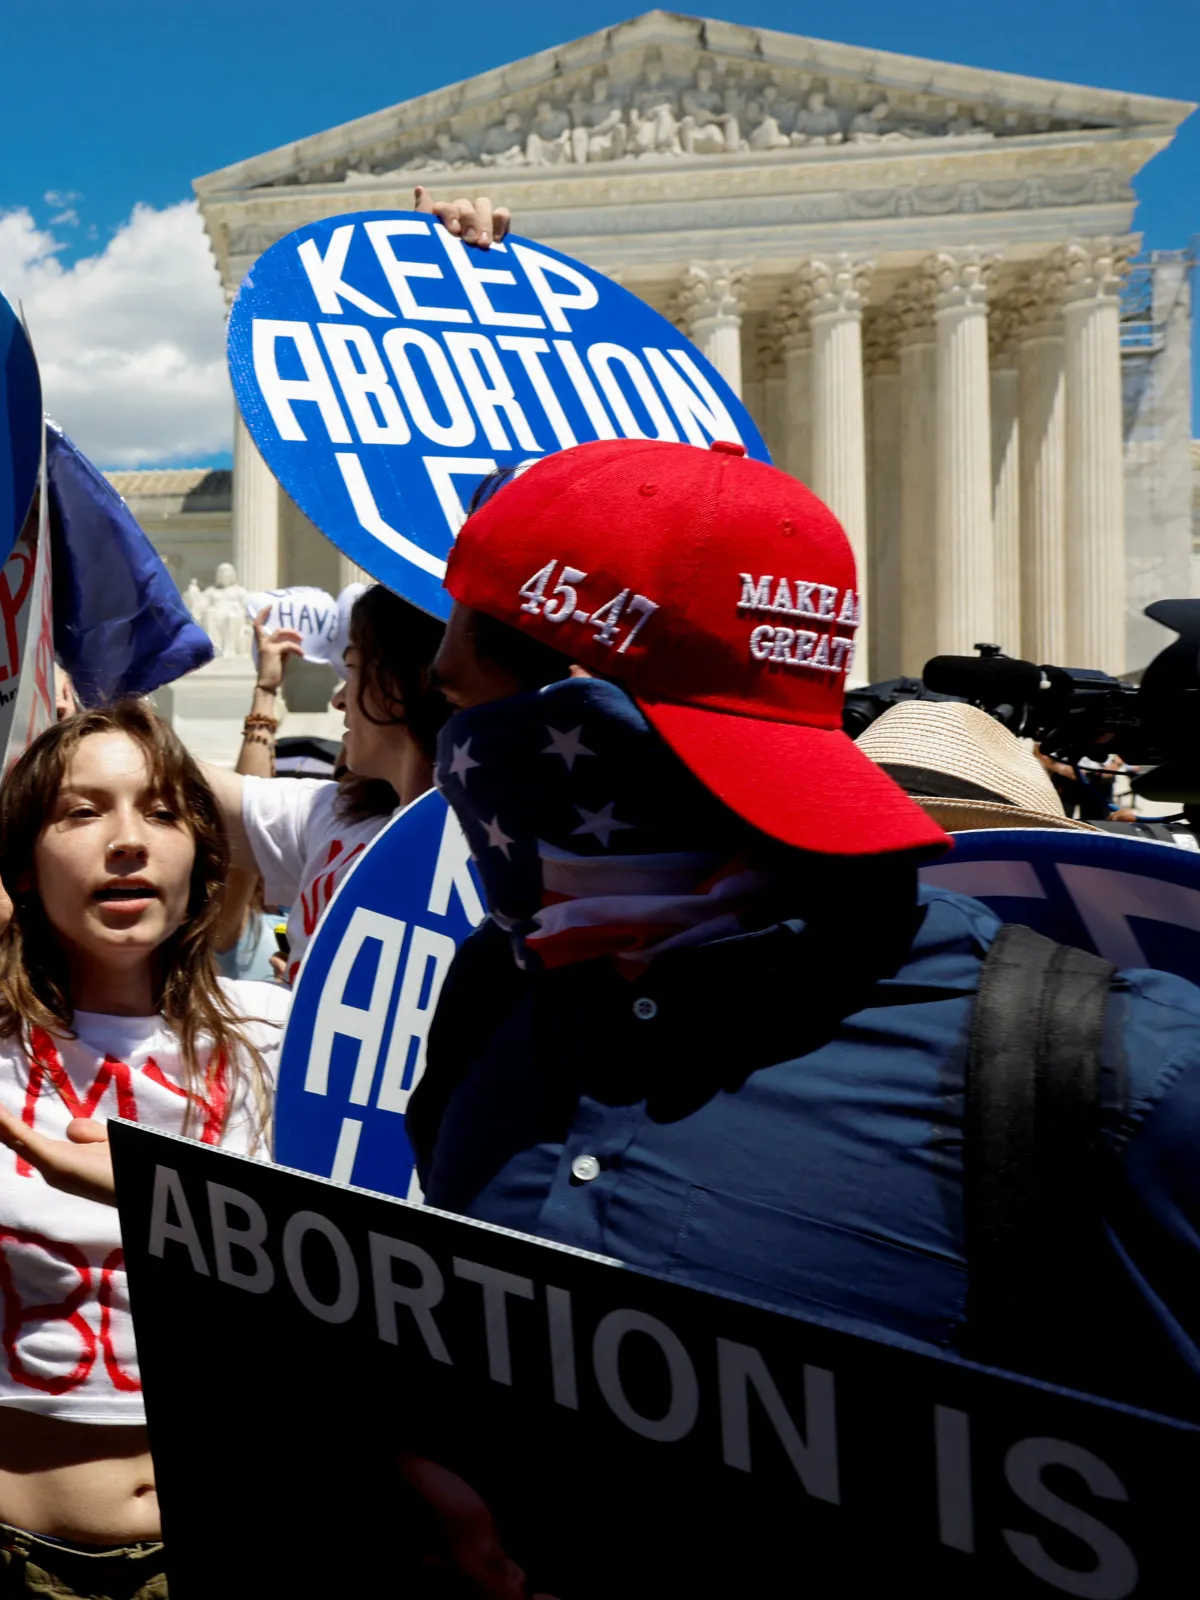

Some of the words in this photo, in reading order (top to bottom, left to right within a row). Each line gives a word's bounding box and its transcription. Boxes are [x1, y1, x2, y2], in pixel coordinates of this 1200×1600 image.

[297, 219, 599, 333] KEEP
[252, 318, 747, 452] ABORTION
[518, 558, 660, 653] 45-47
[736, 572, 838, 622] MAKE
[749, 625, 854, 672] GREAT
[148, 1163, 842, 1506] ABORTION
[932, 1402, 1140, 1600] IS
